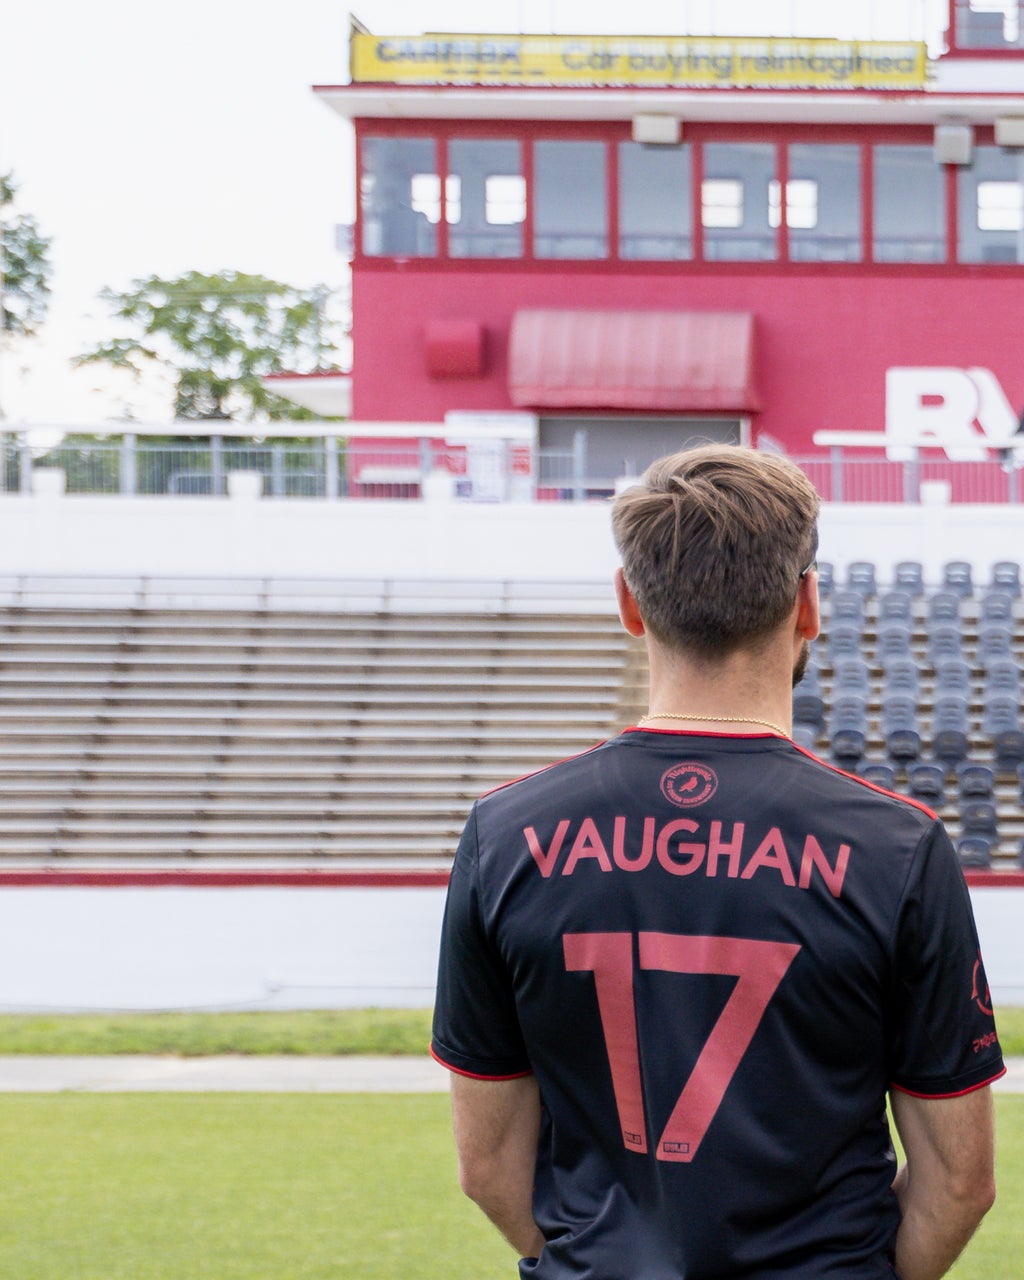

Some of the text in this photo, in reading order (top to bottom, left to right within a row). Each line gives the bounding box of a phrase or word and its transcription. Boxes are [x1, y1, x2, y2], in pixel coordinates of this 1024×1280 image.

[561, 42, 915, 79] Car buying reimagined
[523, 817, 850, 898] VAUGHAN
[562, 931, 802, 1163] 17
